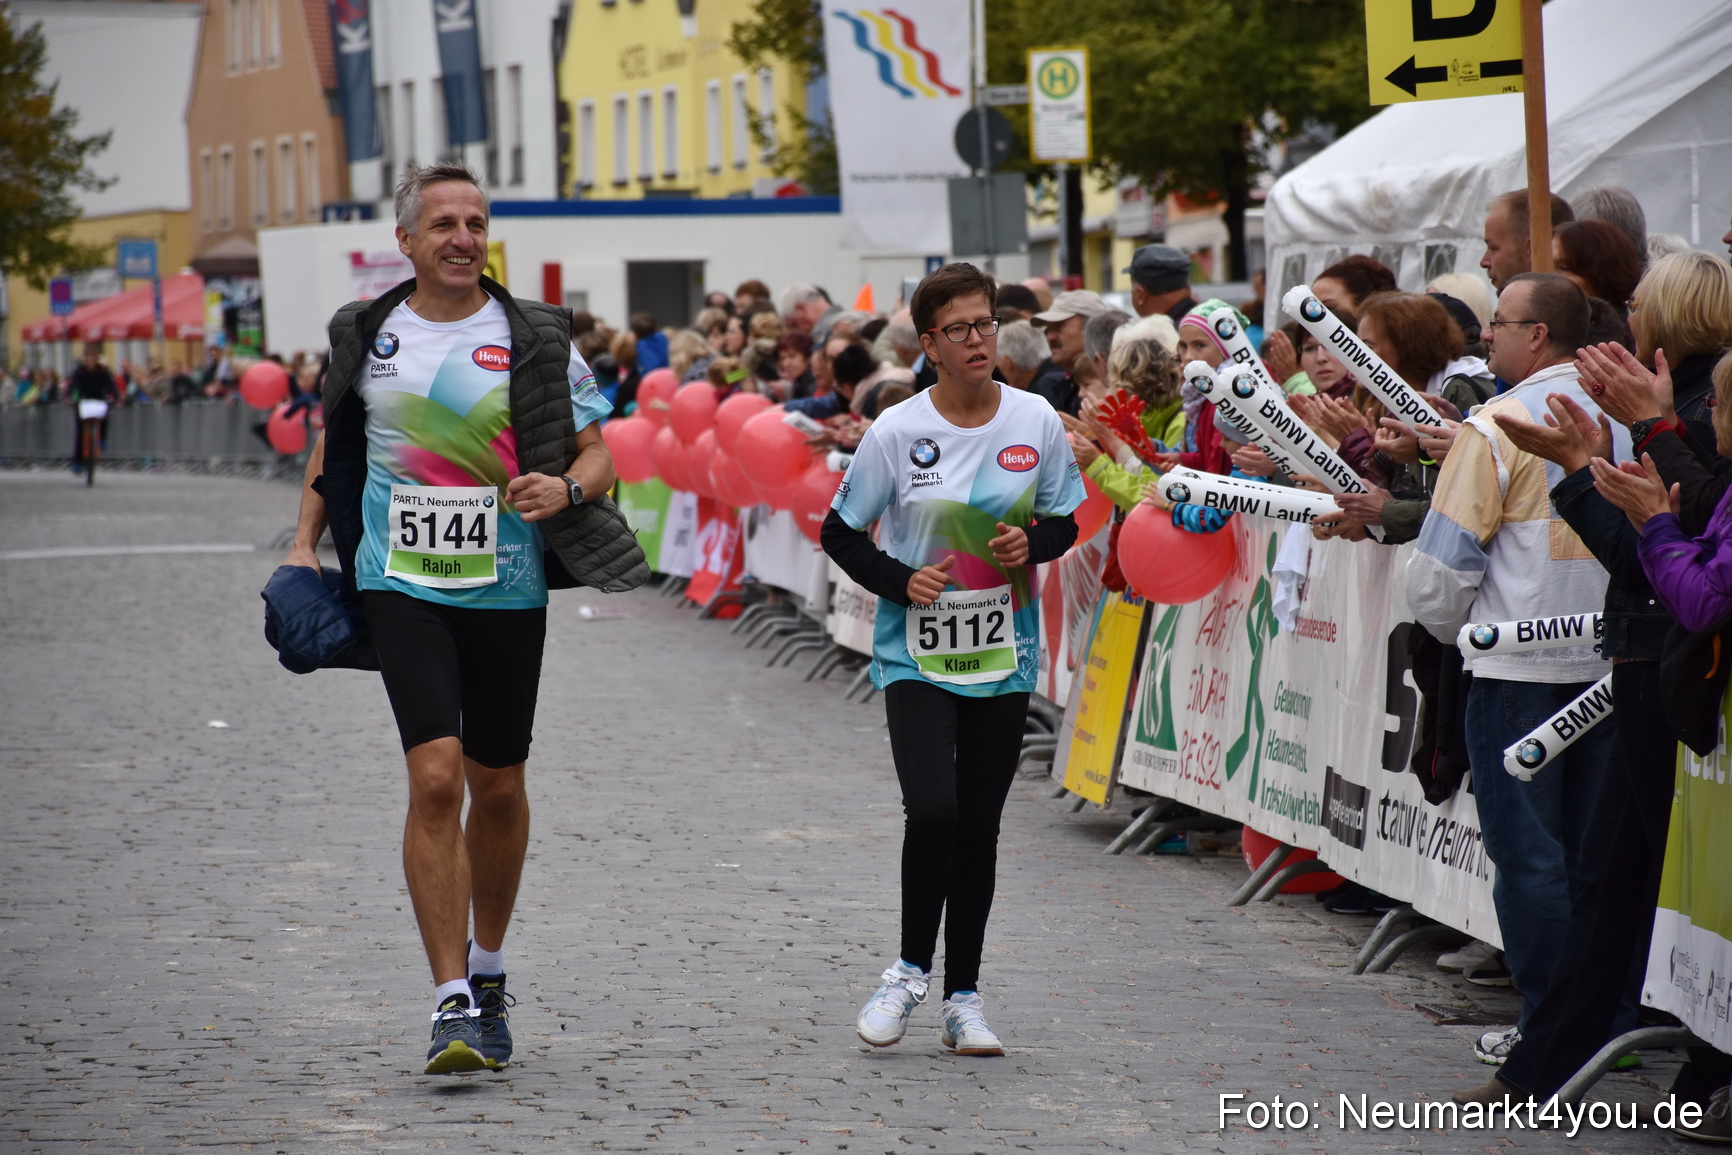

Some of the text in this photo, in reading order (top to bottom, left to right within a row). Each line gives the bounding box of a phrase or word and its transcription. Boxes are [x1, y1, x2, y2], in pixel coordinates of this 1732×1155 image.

[370, 363, 398, 373] PARTL
[370, 371, 398, 379] Neumarkt
[1258, 397, 1370, 494] BMW Laufsp
[1003, 452, 1035, 464] Hervis
[911, 472, 943, 482] PARTL
[911, 480, 944, 488] Neumarkt
[393, 494, 479, 507] PARTL Neumarkt
[1204, 490, 1261, 516] BMW
[400, 510, 488, 549] 5144
[422, 558, 461, 577] Ralph
[908, 598, 997, 612] PARTL Neumarkt
[919, 610, 1005, 650] 5112
[1516, 614, 1585, 643] BMW
[944, 658, 980, 672] Klara
[1550, 683, 1614, 742] BMW
